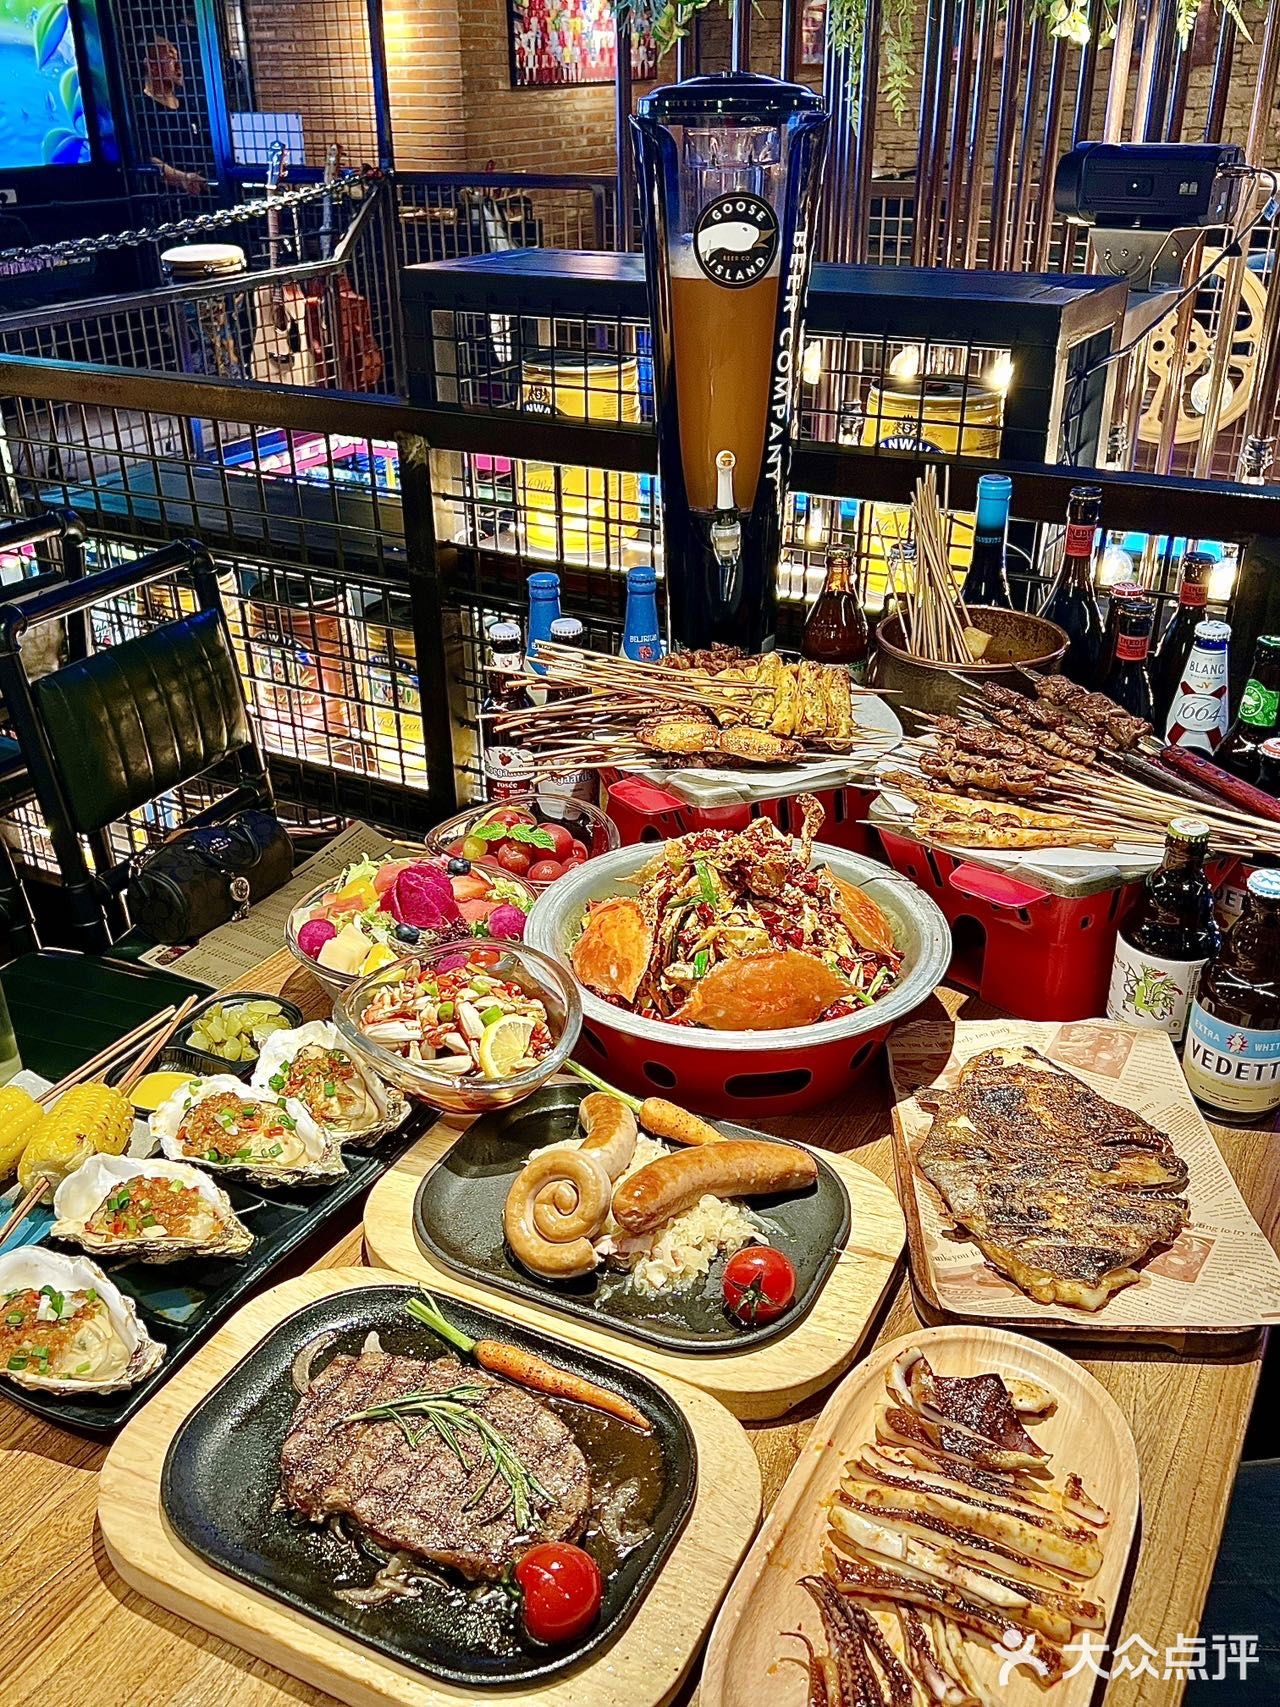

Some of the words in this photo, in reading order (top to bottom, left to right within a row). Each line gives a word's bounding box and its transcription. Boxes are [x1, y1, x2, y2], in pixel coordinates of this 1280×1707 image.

[711, 201, 767, 222] GOOSE
[708, 258, 765, 280] ISLAND
[783, 231, 806, 312] BEER
[765, 327, 794, 490] COMPANY
[1189, 660, 1225, 675] BLANC
[1177, 701, 1222, 723] 1664
[1194, 1019, 1220, 1042] EXTRA
[1192, 1037, 1280, 1081] VEDETT
